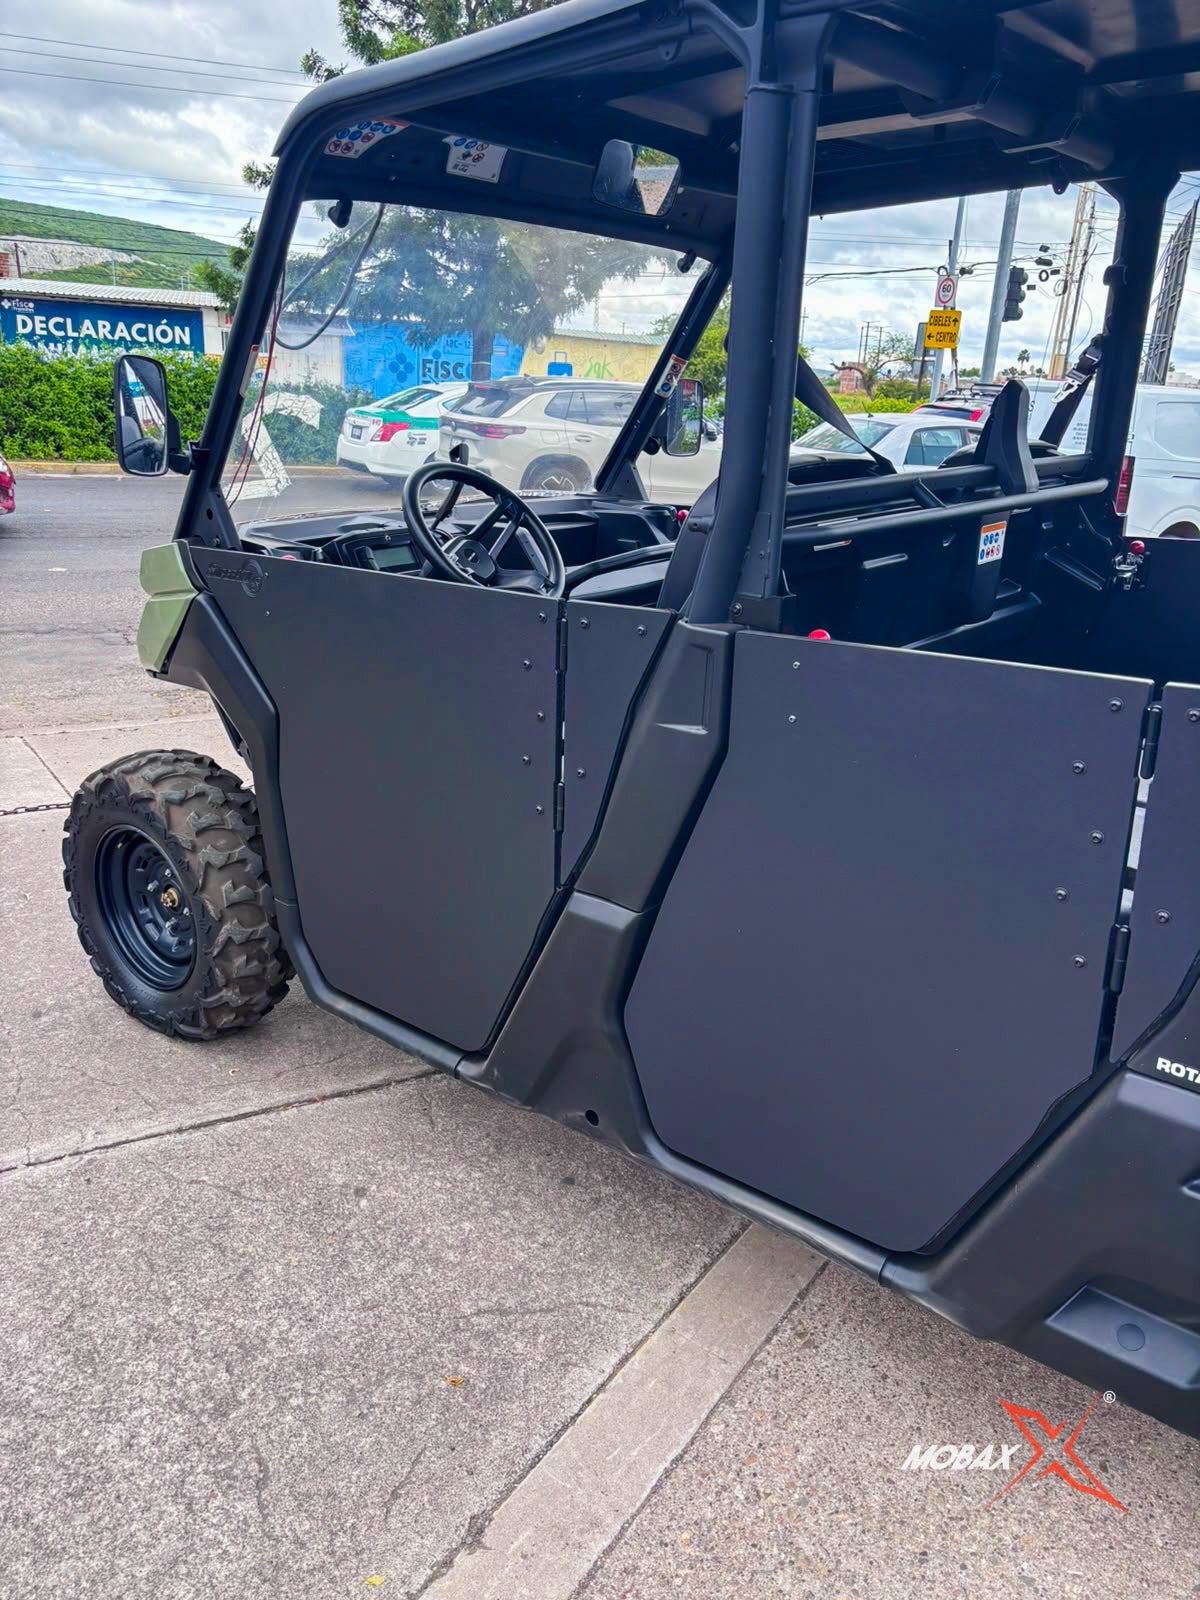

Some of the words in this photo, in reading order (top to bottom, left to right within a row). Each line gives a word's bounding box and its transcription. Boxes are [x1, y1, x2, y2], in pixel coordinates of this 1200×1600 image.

[941, 283, 952, 293] 60
[16, 314, 191, 346] DECLARACIÓN
[935, 331, 957, 343] CENTRO
